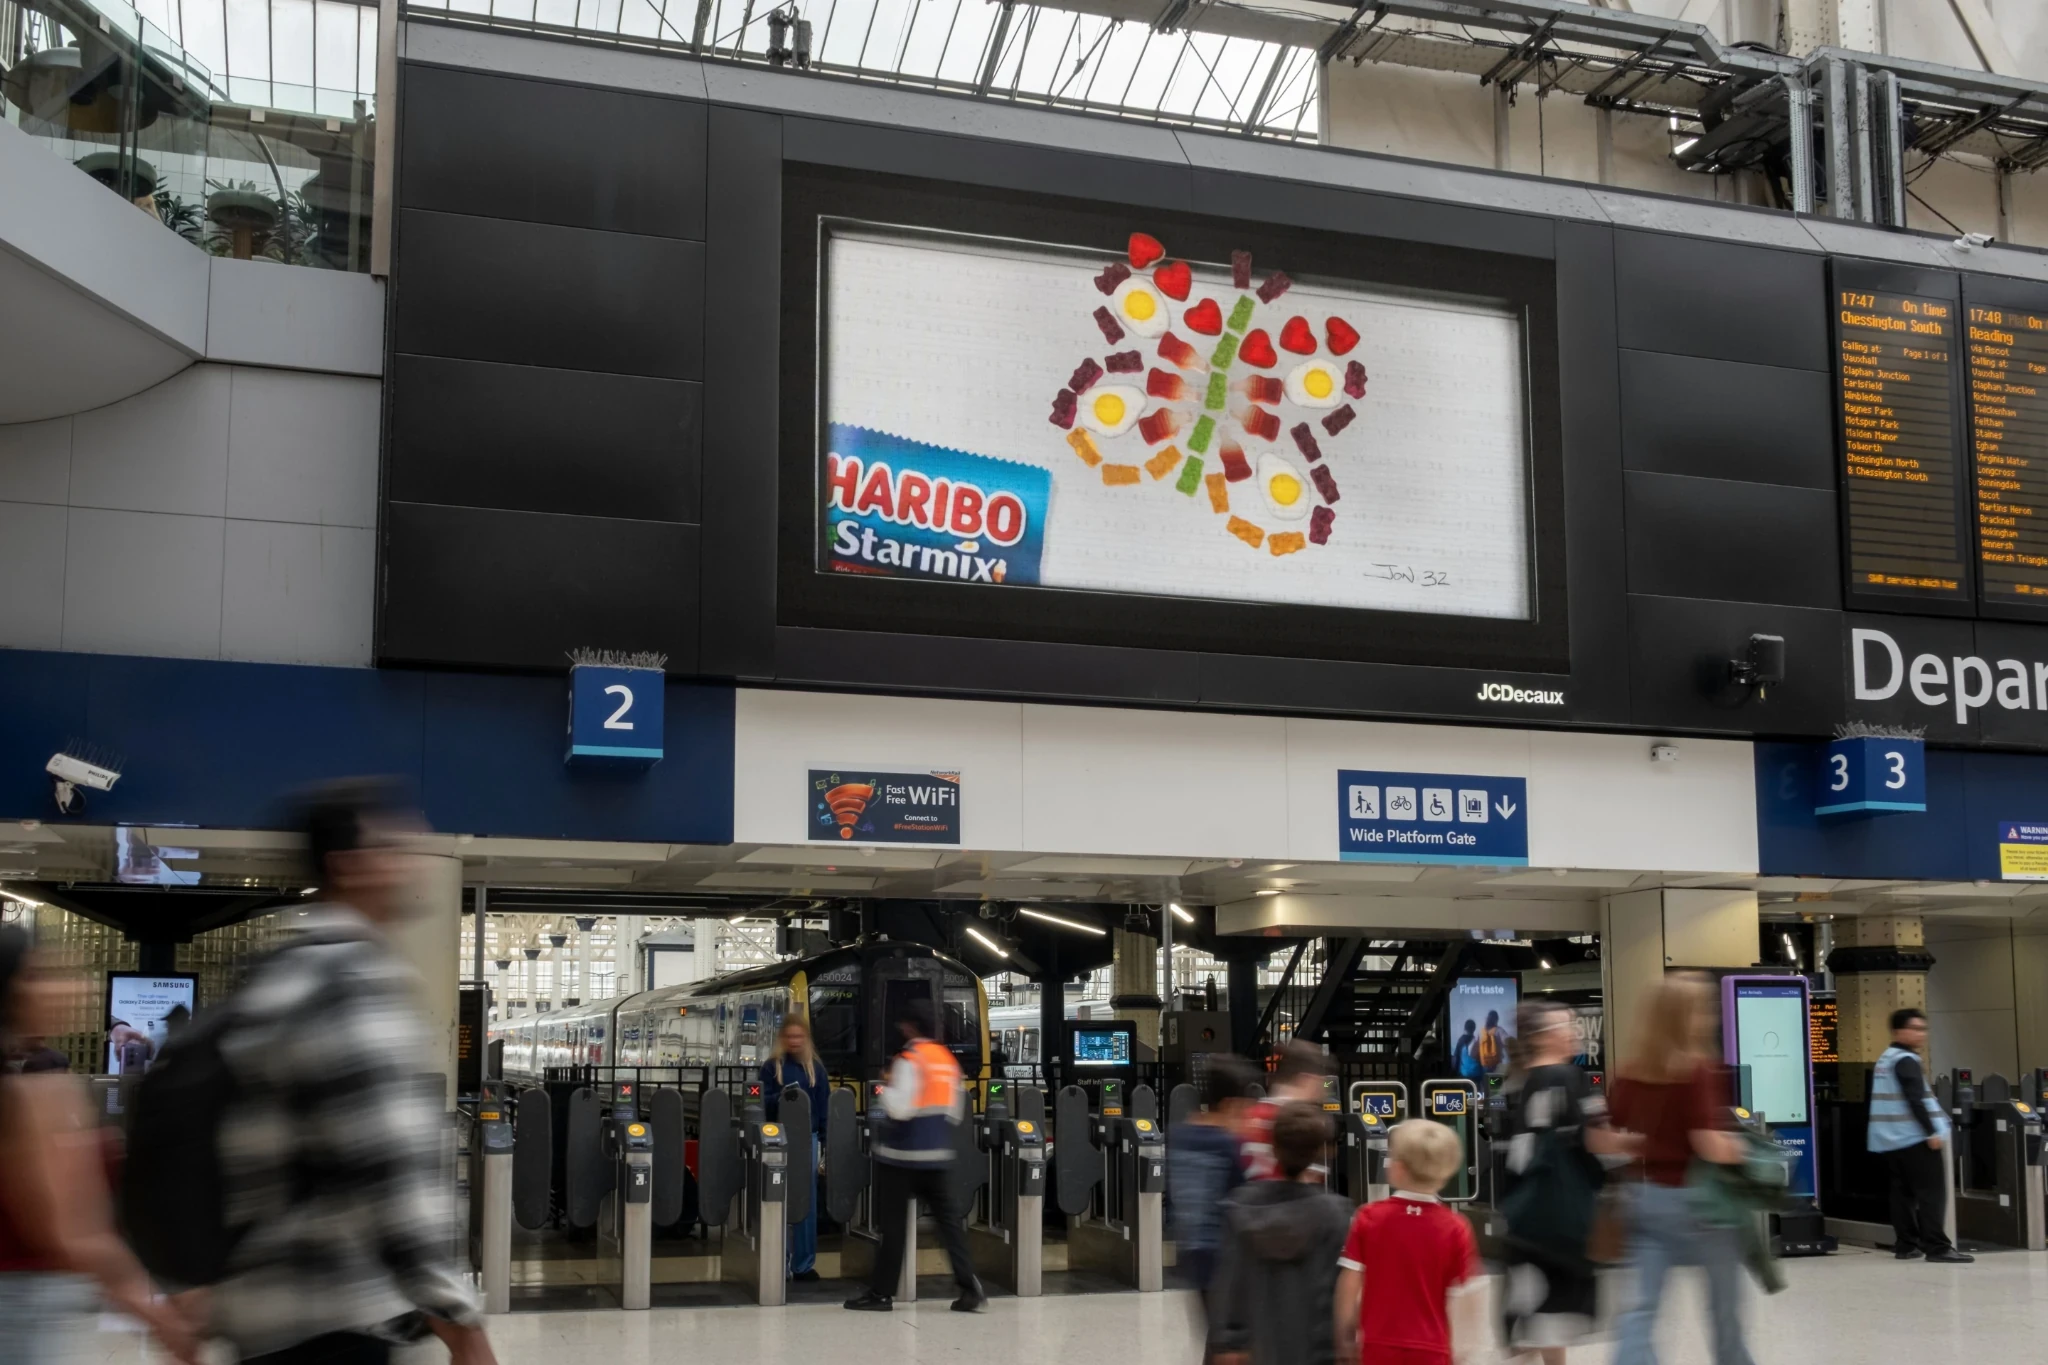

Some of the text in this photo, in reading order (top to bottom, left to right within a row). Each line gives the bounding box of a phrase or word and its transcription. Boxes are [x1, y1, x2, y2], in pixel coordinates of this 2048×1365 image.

[1841, 293, 1946, 317] 17:47 On time
[1841, 312, 1941, 334] Chessington South
[1970, 309, 2001, 324] 17:48
[2028, 317, 2042, 329] On
[1970, 327, 2013, 345] Reading
[1842, 341, 1868, 353] Calling
[1904, 348, 1922, 359] Page
[1932, 352, 1942, 360] of
[1985, 346, 2009, 356] Ascot
[1843, 354, 1877, 365] Vauxhall
[1971, 356, 1996, 368] Calling
[2028, 363, 2046, 373] Page
[1878, 370, 1910, 380] Junction
[1972, 369, 2004, 379] Vauxhall
[1844, 379, 1882, 390] Earlsfield
[2005, 385, 2035, 395] Junction
[1844, 391, 1882, 402] Wimbledon
[1973, 393, 2006, 403] Richmond
[1845, 403, 1893, 416] Raynes Park
[1974, 405, 2016, 416] Twickenham
[1845, 417, 1898, 429] Motspur Park
[1975, 417, 2003, 427] Feltham
[1846, 429, 1898, 441] Malden Manor
[1976, 429, 2002, 439] Staines
[1847, 441, 1882, 452] Tolworth
[1847, 454, 1919, 468] Chessington North
[1977, 455, 2028, 466] Virginia Water
[1857, 468, 1902, 479] Chessington
[1906, 472, 1928, 482] South
[1977, 467, 2015, 478] Longcross
[1978, 479, 2020, 490] Sunningdale
[827, 454, 1024, 544] HARIBO
[1979, 491, 2000, 499] Ascot
[1979, 503, 2031, 514] Martins Heron
[1980, 516, 2015, 525] Bracknell
[1981, 540, 2013, 549] Winnersh
[833, 520, 996, 583] Starmix
[1982, 552, 2048, 565] Winnersh Triangle
[1421, 570, 1450, 586] 32
[1477, 683, 1564, 705] JCDecaux
[604, 685, 633, 729] 2
[88, 769, 109, 780] PHILIPS
[1830, 754, 1849, 791] 3
[1885, 751, 1906, 789] 3
[886, 785, 905, 794] Fast
[886, 795, 906, 804] Free
[908, 786, 955, 806] WiFi
[893, 823, 948, 831] #FreeStationWiFi
[1350, 828, 1476, 845] Wide Platform Gate
[817, 973, 852, 982] 450024
[943, 974, 969, 983] 50024
[152, 981, 190, 989] SAMSUNG
[1459, 984, 1504, 995] First taste
[823, 991, 853, 999] oking
[1782, 1138, 1806, 1146] screen
